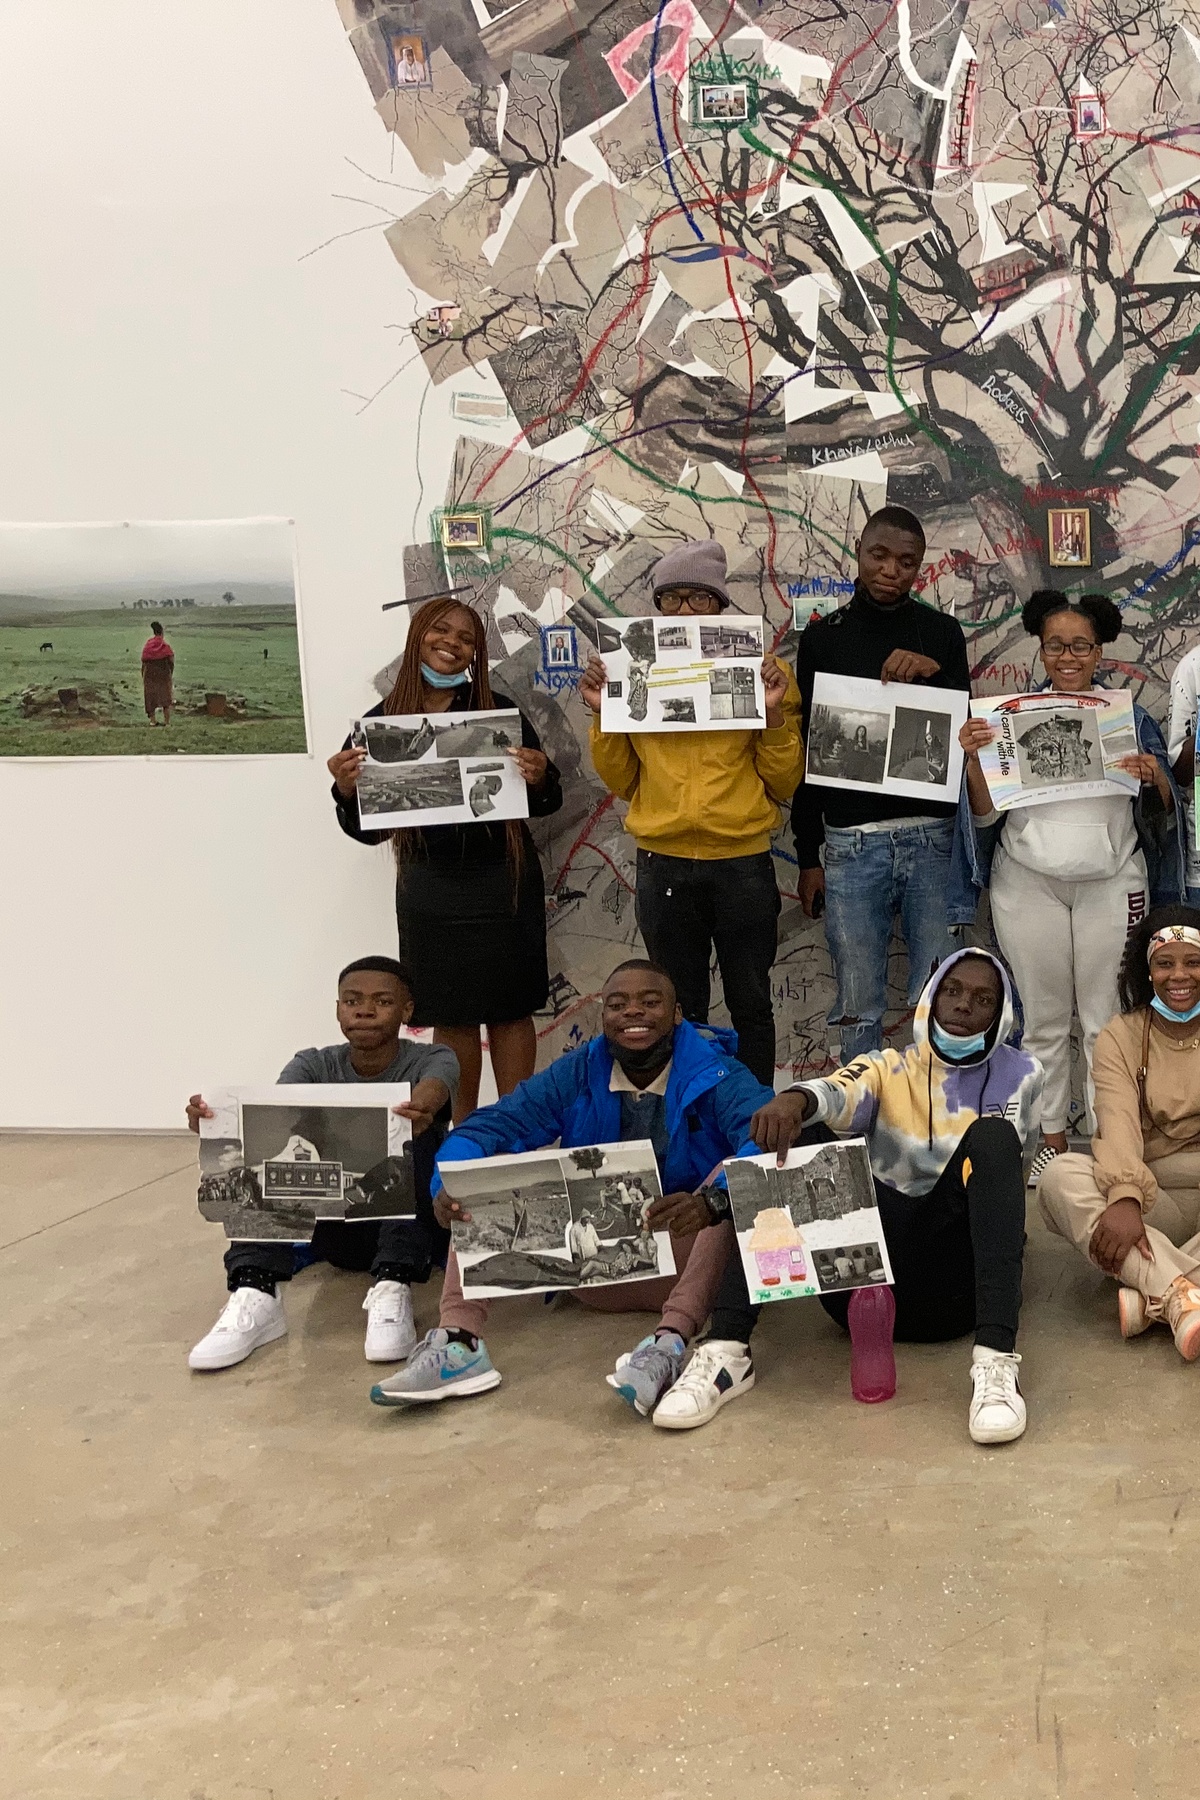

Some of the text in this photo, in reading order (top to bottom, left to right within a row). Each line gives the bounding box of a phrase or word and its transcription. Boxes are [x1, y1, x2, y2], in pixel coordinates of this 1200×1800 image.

[1001, 717, 1012, 741] carry
[996, 741, 1011, 776] with Me
[1006, 742, 1016, 760] Her
